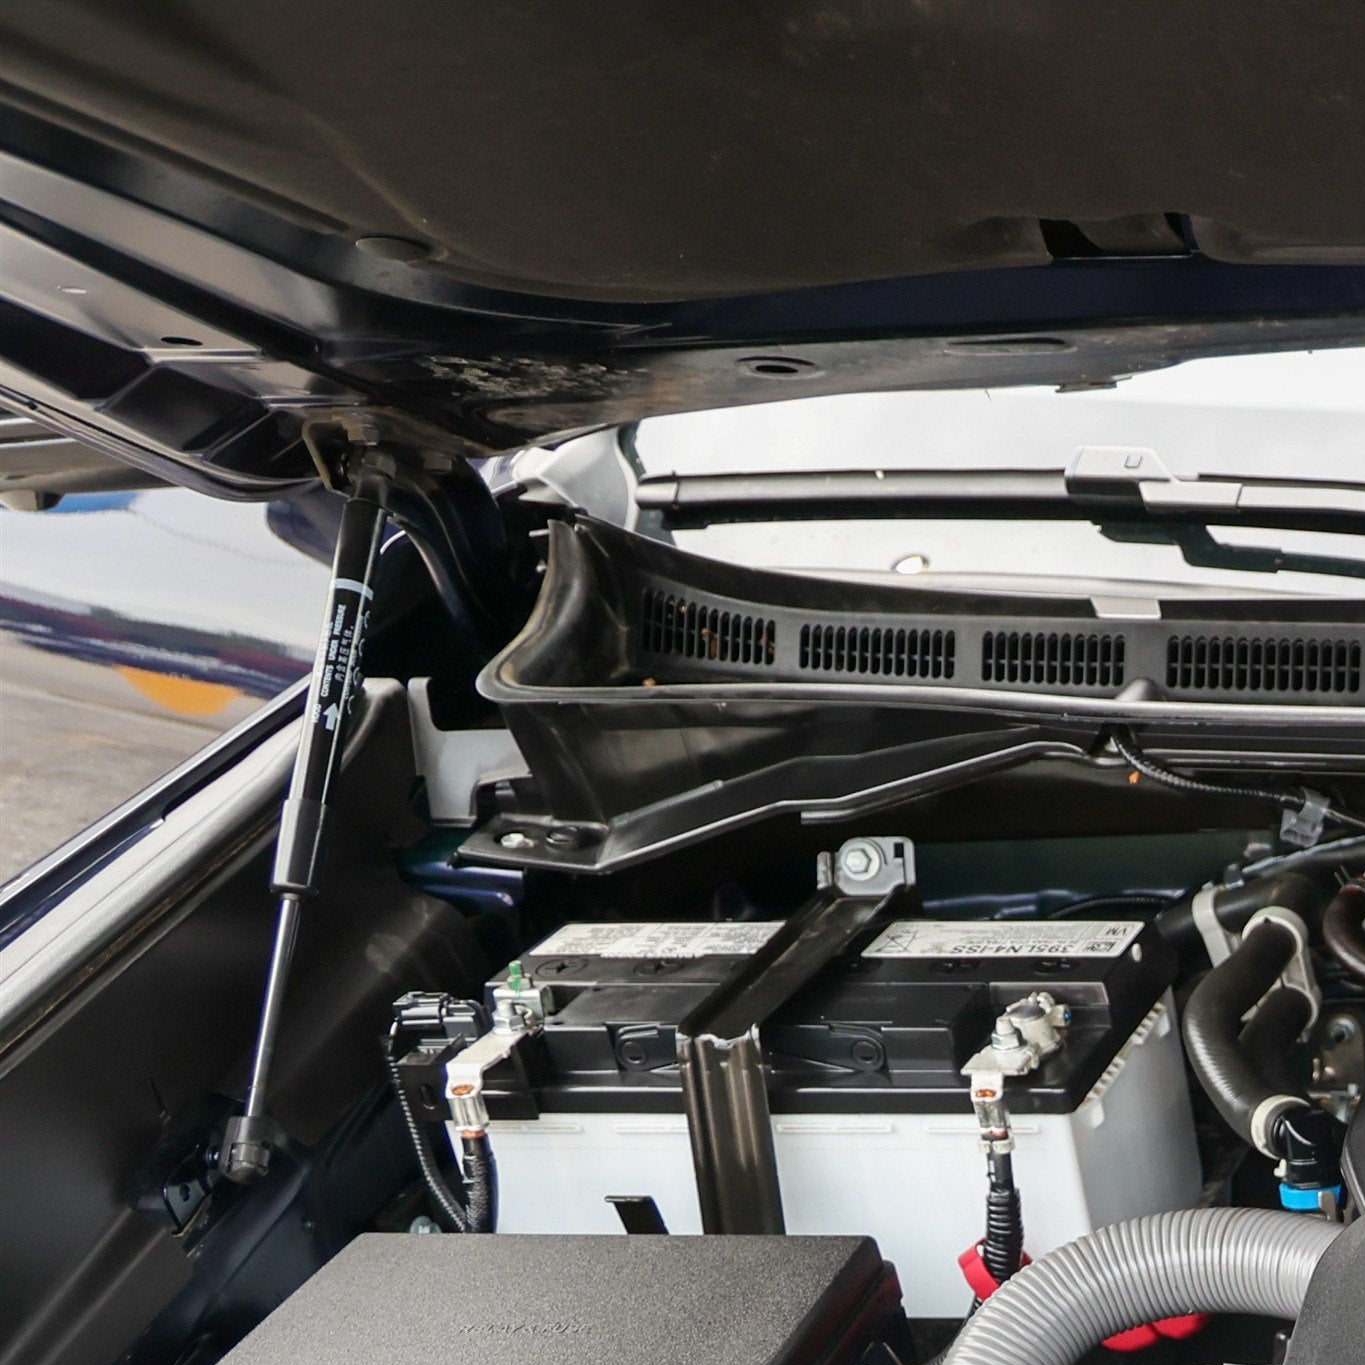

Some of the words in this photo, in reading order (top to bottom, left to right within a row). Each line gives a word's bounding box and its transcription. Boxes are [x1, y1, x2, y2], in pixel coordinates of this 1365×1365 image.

[332, 604, 347, 636] PRESSURE
[327, 639, 339, 661] UNDER
[320, 664, 334, 698] CONTENTS
[950, 944, 1075, 954] 395LN4-ISS
